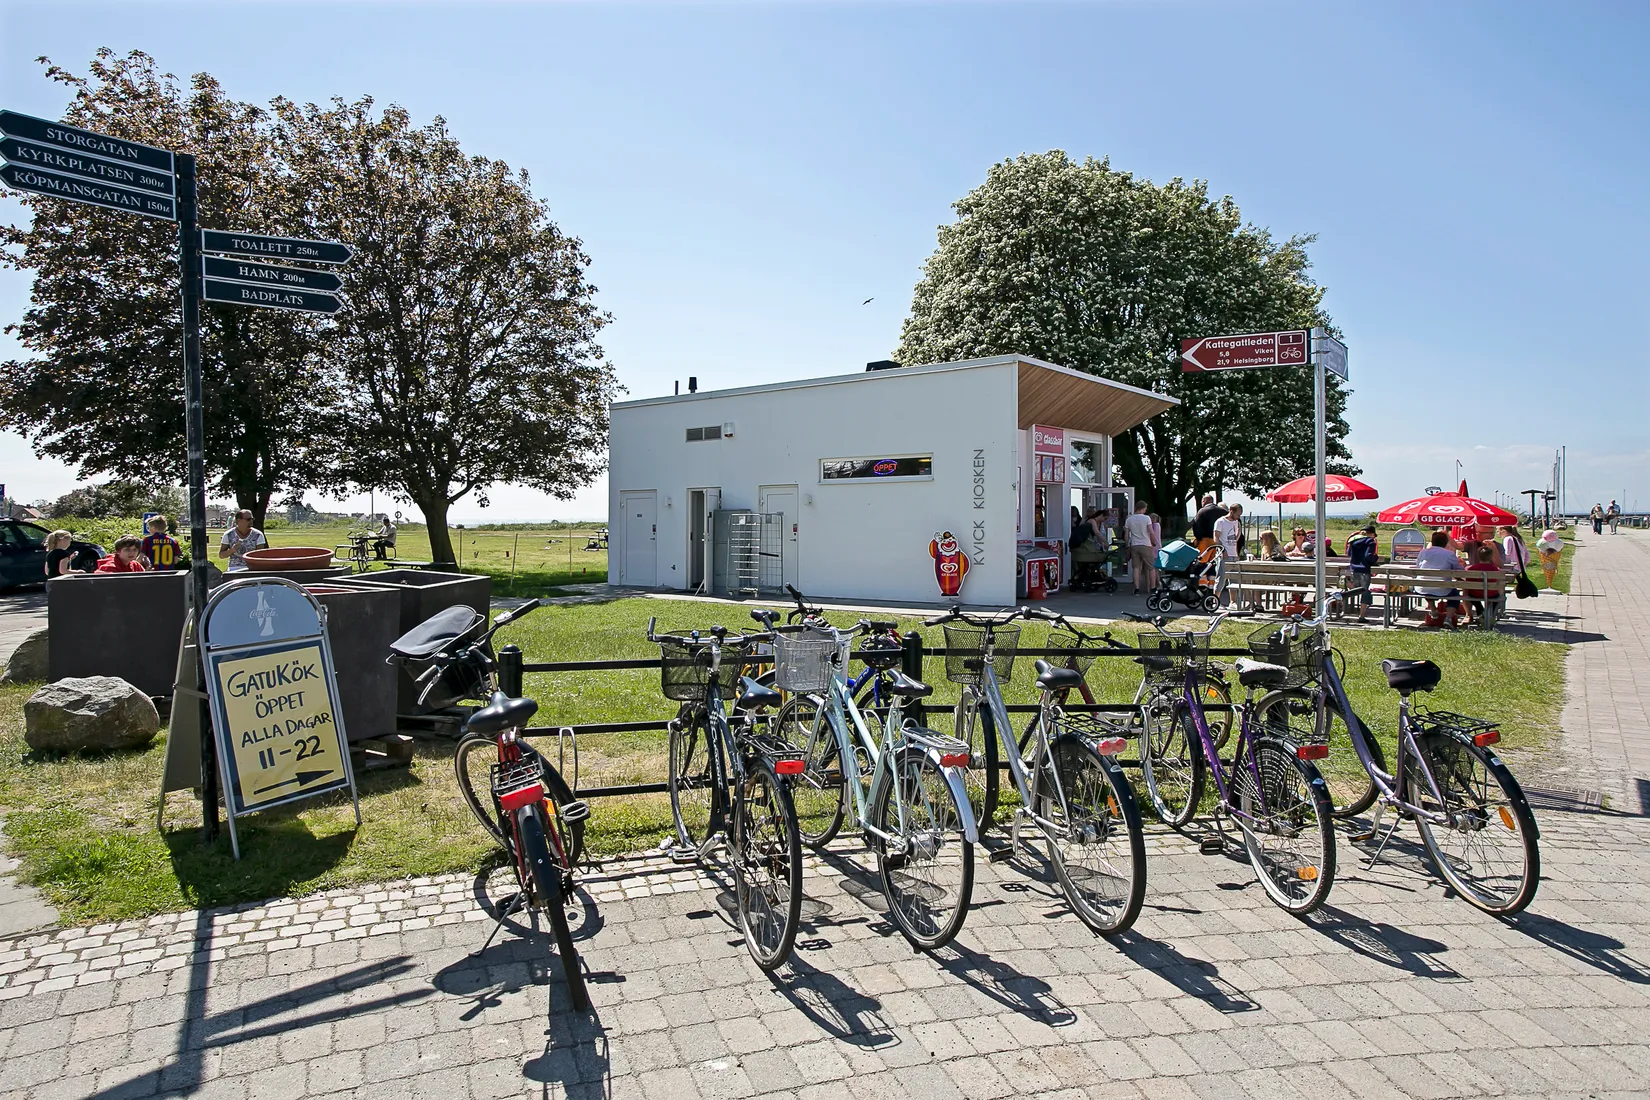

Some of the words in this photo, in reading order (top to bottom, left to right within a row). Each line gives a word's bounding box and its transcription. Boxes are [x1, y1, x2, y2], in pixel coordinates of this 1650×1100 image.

[46, 127, 139, 159] STORGATAN
[16, 146, 135, 182] KYRKPLATSEN
[13, 170, 141, 208] KÖPMANSGATAN
[231, 238, 292, 254] TOALETT
[239, 266, 280, 281] HAMN
[241, 289, 304, 306] BADPLATS
[1205, 337, 1274, 350] Kattegattleden
[1288, 335, 1293, 343] 1
[1233, 356, 1274, 365] Helsingborg
[973, 448, 985, 510] KIOSKEN
[1421, 515, 1433, 523] GB
[1435, 516, 1466, 524] GLACE
[973, 520, 985, 566] KVICK
[151, 544, 174, 566] 10
[249, 607, 275, 619] Coca-Cola
[227, 660, 320, 698] GATUKÖK
[255, 690, 305, 719] ÖPPET
[241, 723, 284, 748] ALLA
[285, 712, 332, 735] DAGAR
